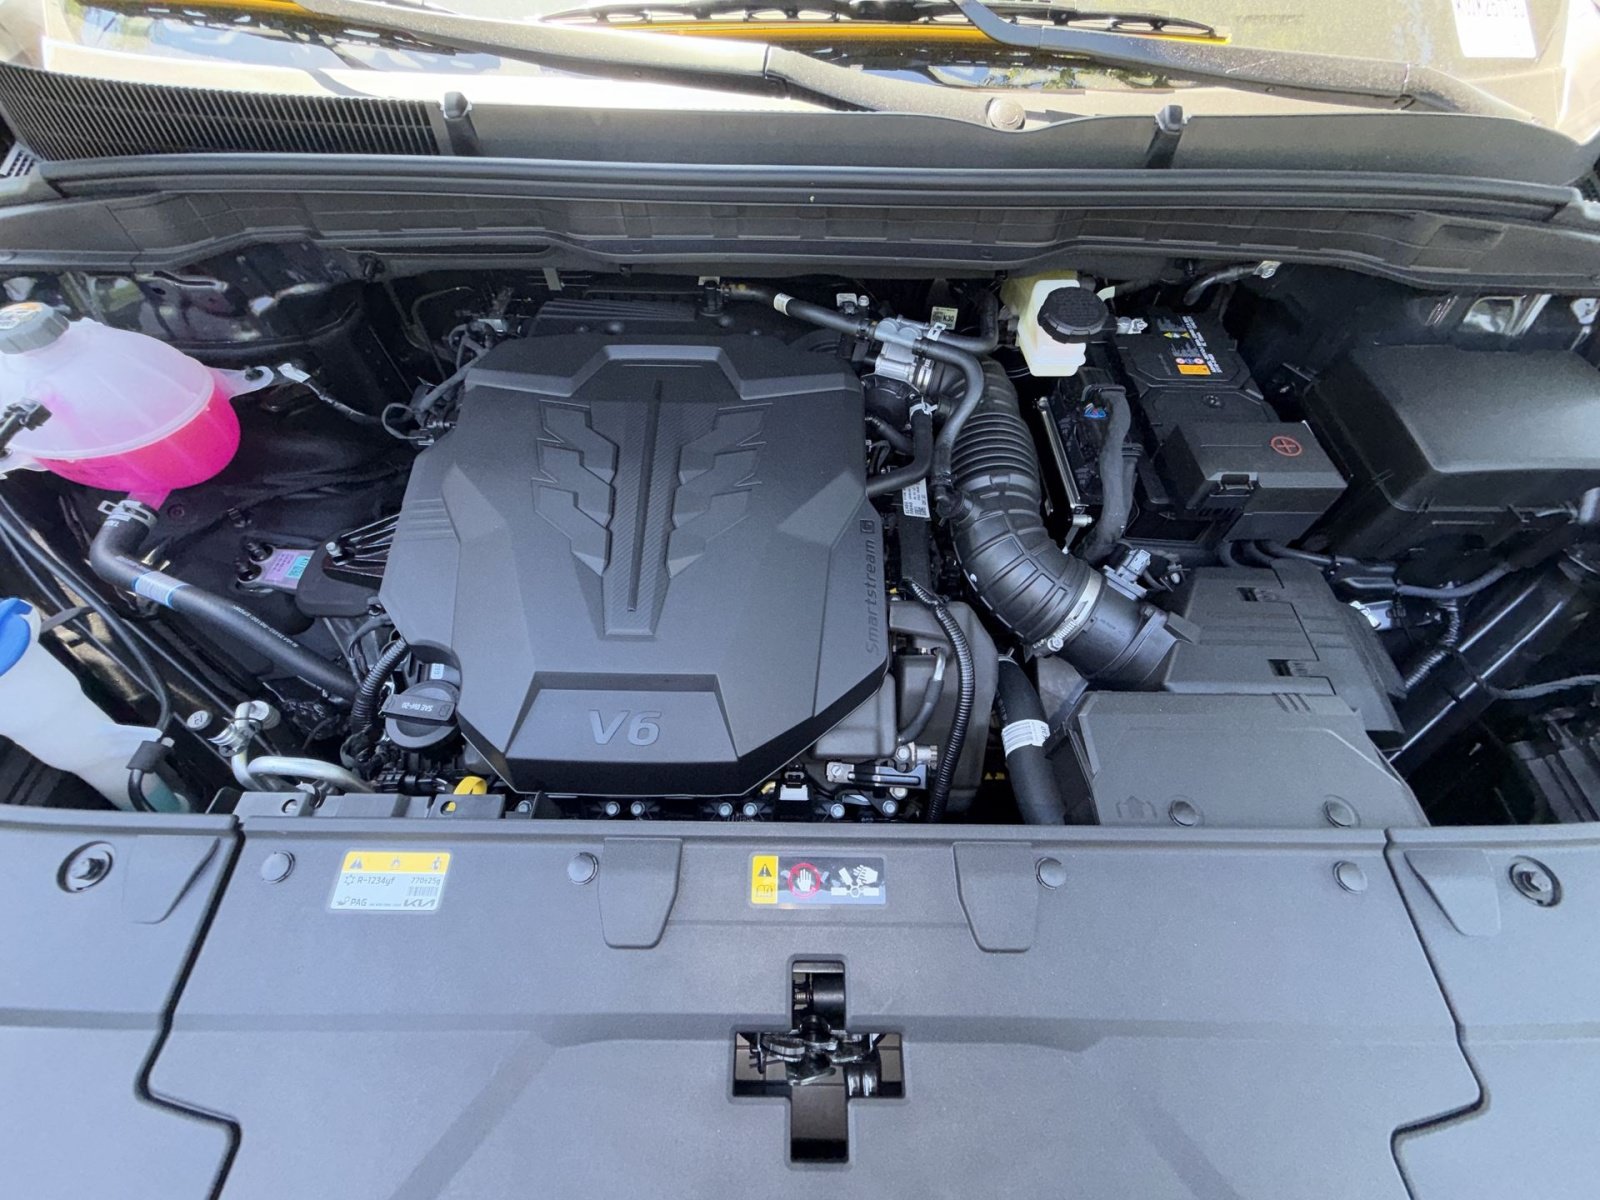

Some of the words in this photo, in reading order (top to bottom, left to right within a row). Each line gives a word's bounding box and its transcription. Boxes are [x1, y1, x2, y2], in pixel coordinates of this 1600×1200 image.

[864, 539, 878, 656] Smartstream
[420, 704, 434, 712] SAE
[587, 709, 662, 747] V6
[357, 876, 396, 886] R-1234yf
[350, 898, 367, 907] PAG
